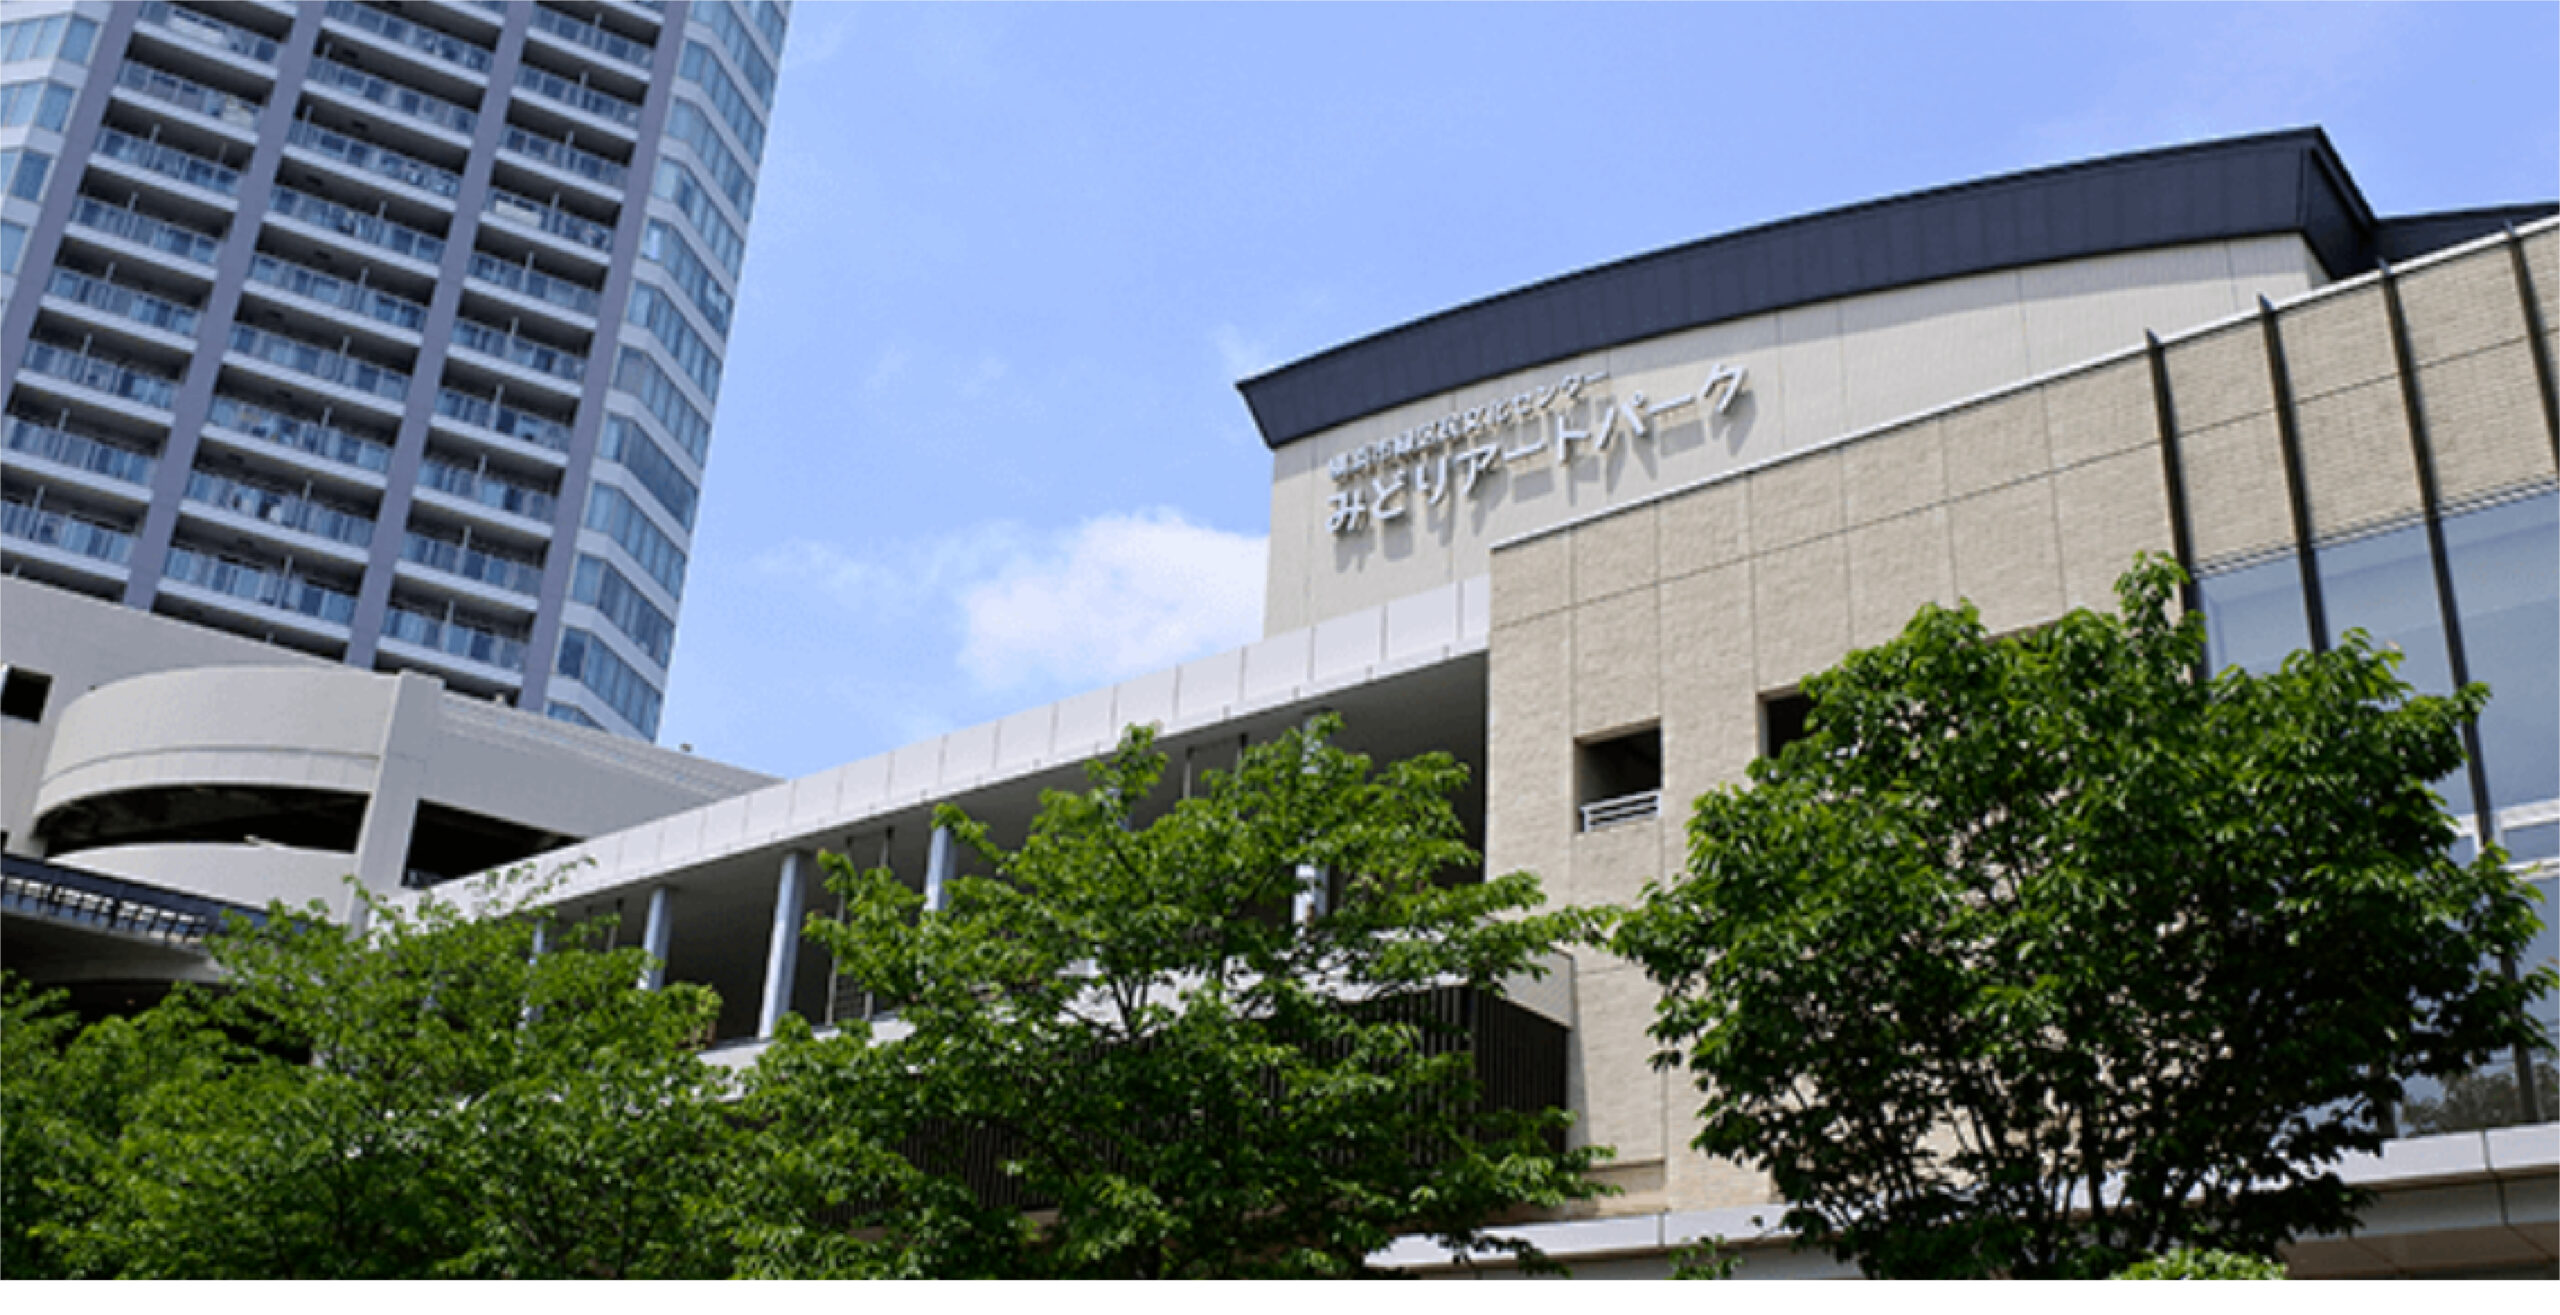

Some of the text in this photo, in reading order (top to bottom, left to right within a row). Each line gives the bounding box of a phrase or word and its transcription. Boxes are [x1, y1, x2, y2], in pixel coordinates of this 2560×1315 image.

[1326, 363, 1747, 532] みどりアートパーク
